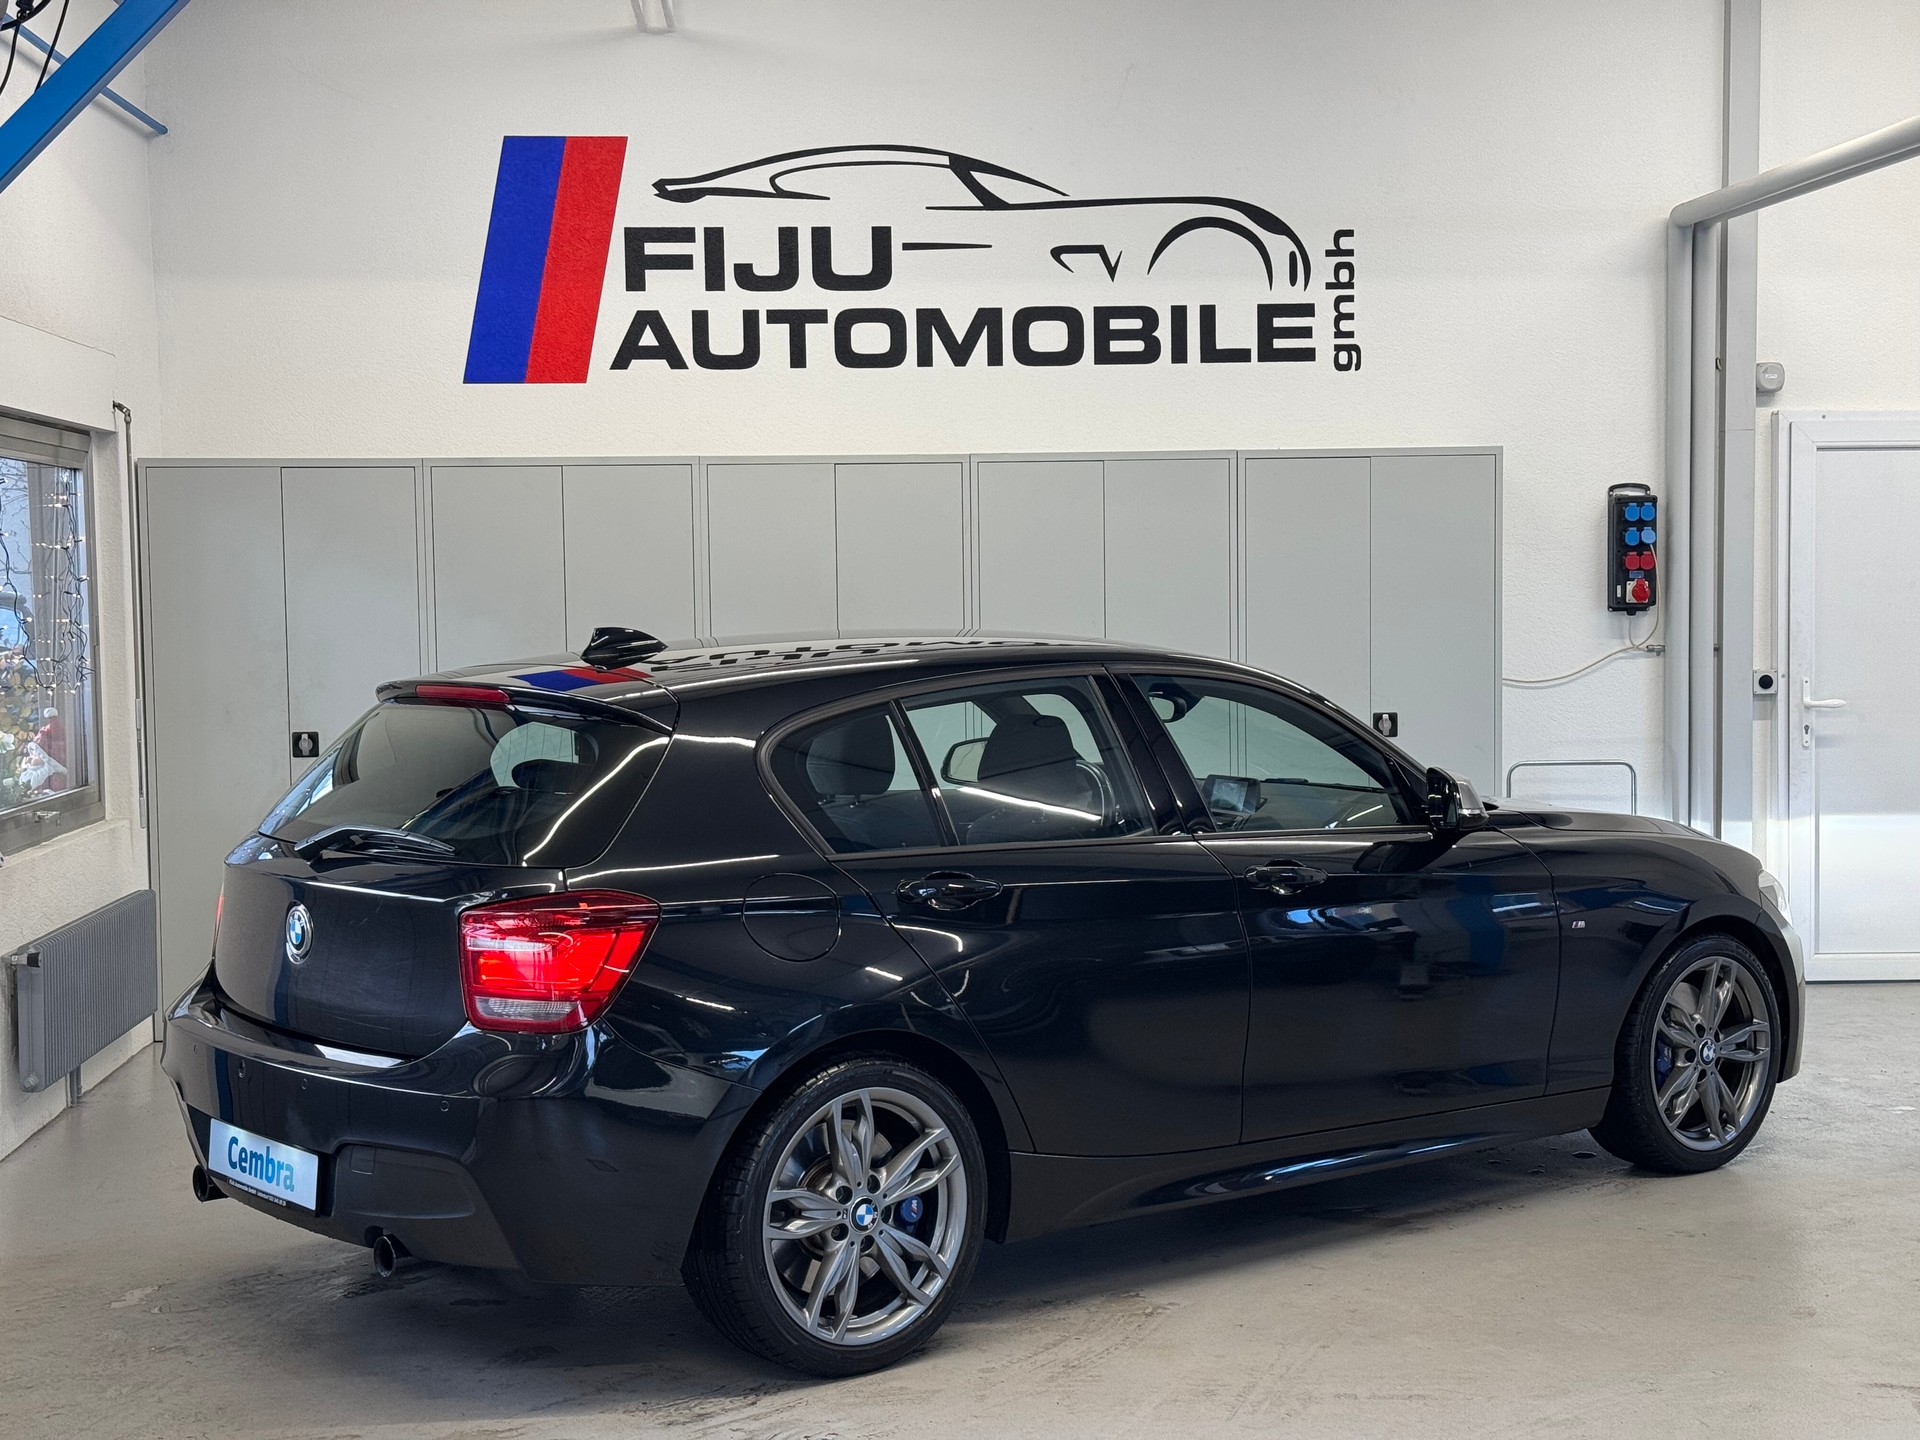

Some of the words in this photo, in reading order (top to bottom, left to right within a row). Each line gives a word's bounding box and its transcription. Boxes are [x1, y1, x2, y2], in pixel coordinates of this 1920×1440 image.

[623, 225, 893, 292] FIJU
[1324, 229, 1362, 372] gmbh
[609, 302, 1316, 371] AUTOMOBILE
[227, 1135, 295, 1192] Cembra
